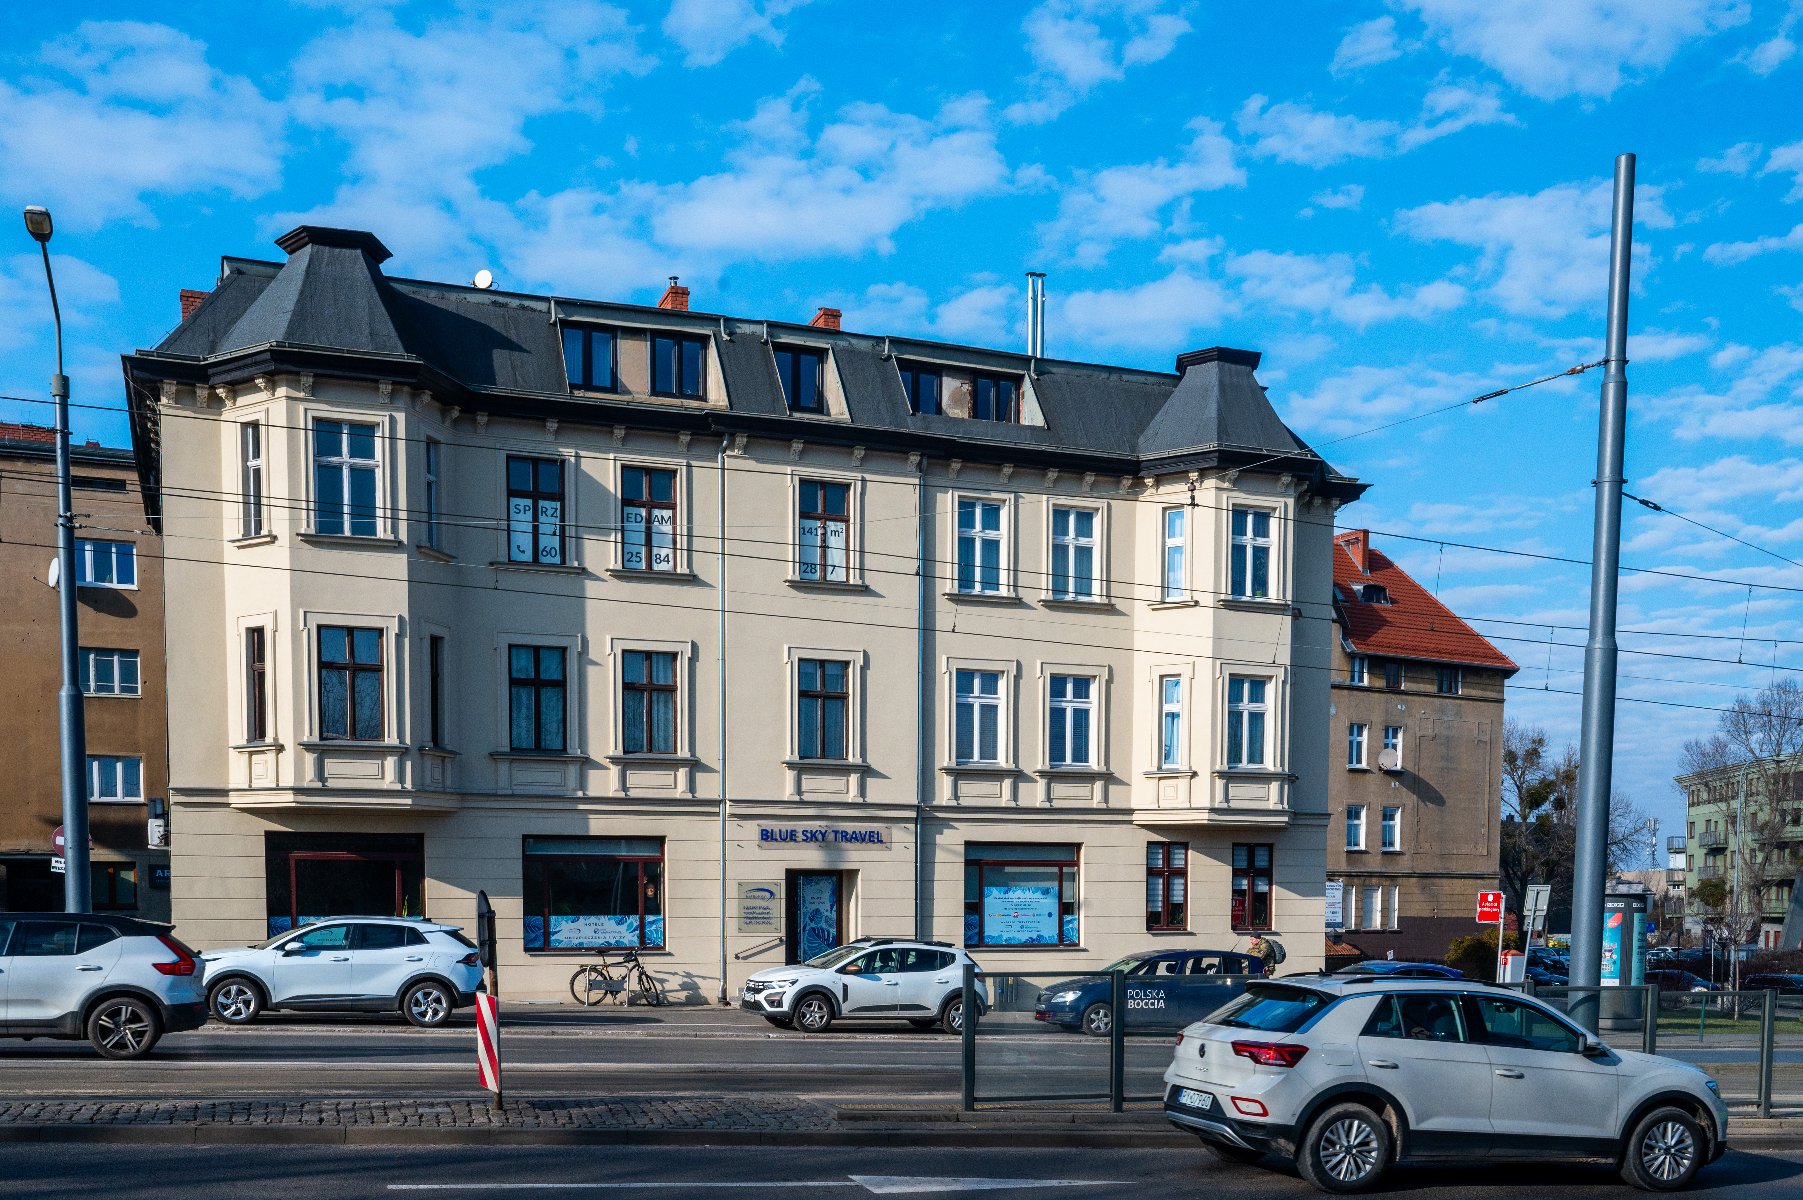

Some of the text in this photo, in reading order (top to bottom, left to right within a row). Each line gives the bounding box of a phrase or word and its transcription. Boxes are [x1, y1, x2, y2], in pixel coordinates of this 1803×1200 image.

[801, 526, 819, 536] 141
[540, 545, 558, 558] 60
[626, 551, 670, 565] 25 84
[760, 828, 884, 843] BLUE SKY TRAVEL
[1127, 989, 1166, 999] POLSKA
[1127, 1000, 1165, 1009] BOCCIA
